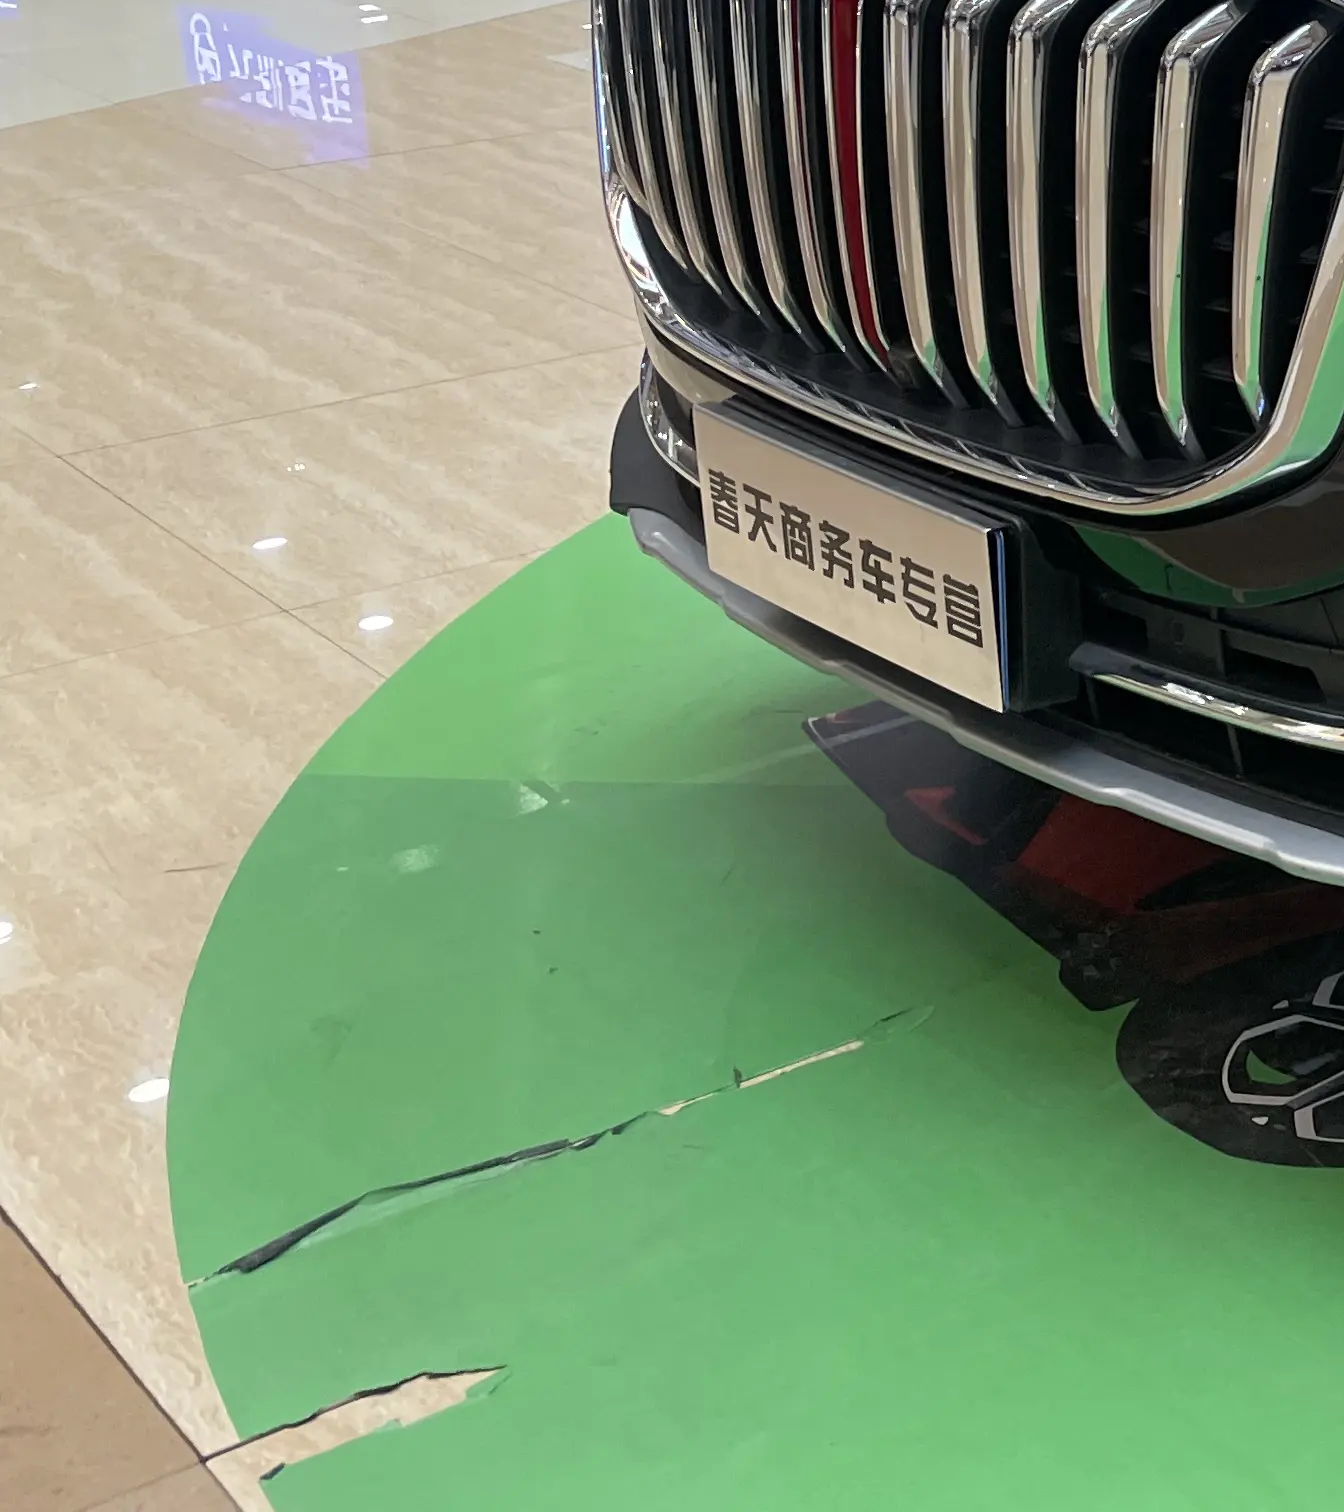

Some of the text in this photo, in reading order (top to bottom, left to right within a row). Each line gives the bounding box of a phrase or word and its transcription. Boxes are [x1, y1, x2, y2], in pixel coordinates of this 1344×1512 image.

[708, 468, 984, 649] 春天商务车专营
